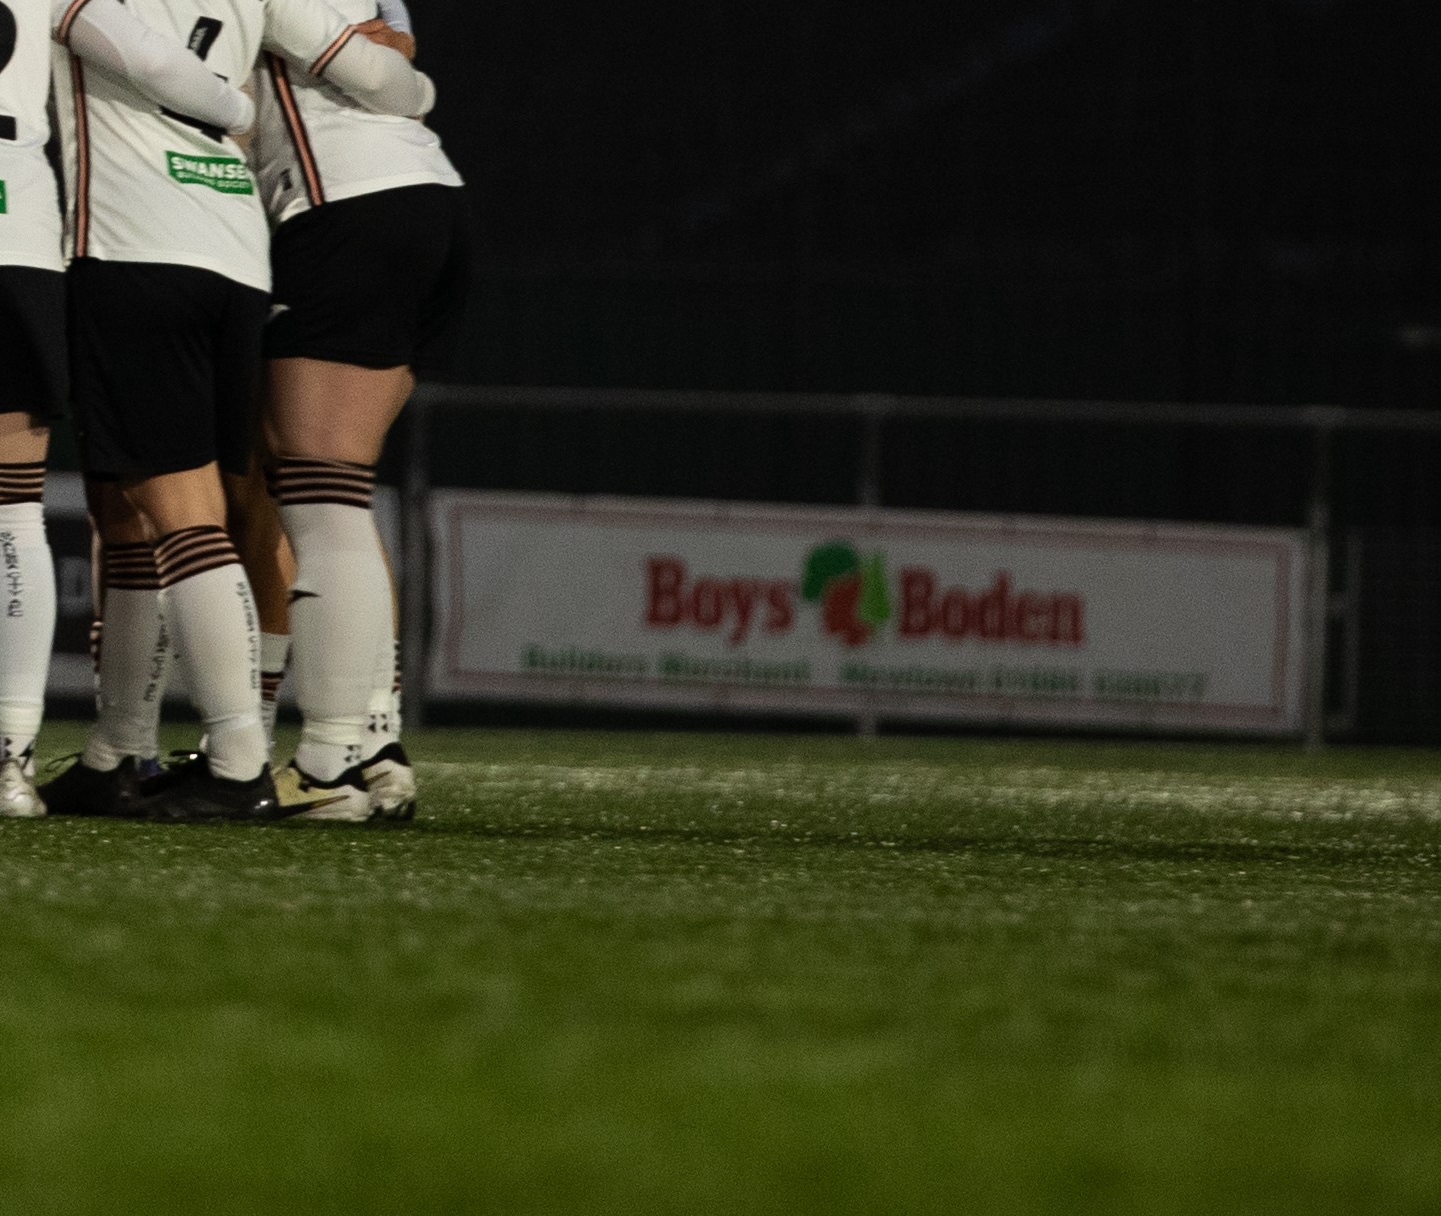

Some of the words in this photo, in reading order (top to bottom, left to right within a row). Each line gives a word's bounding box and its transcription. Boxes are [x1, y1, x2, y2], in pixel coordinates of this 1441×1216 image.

[170, 156, 251, 180] SWANSE
[645, 556, 797, 646] Boys
[898, 568, 1086, 647] Boden
